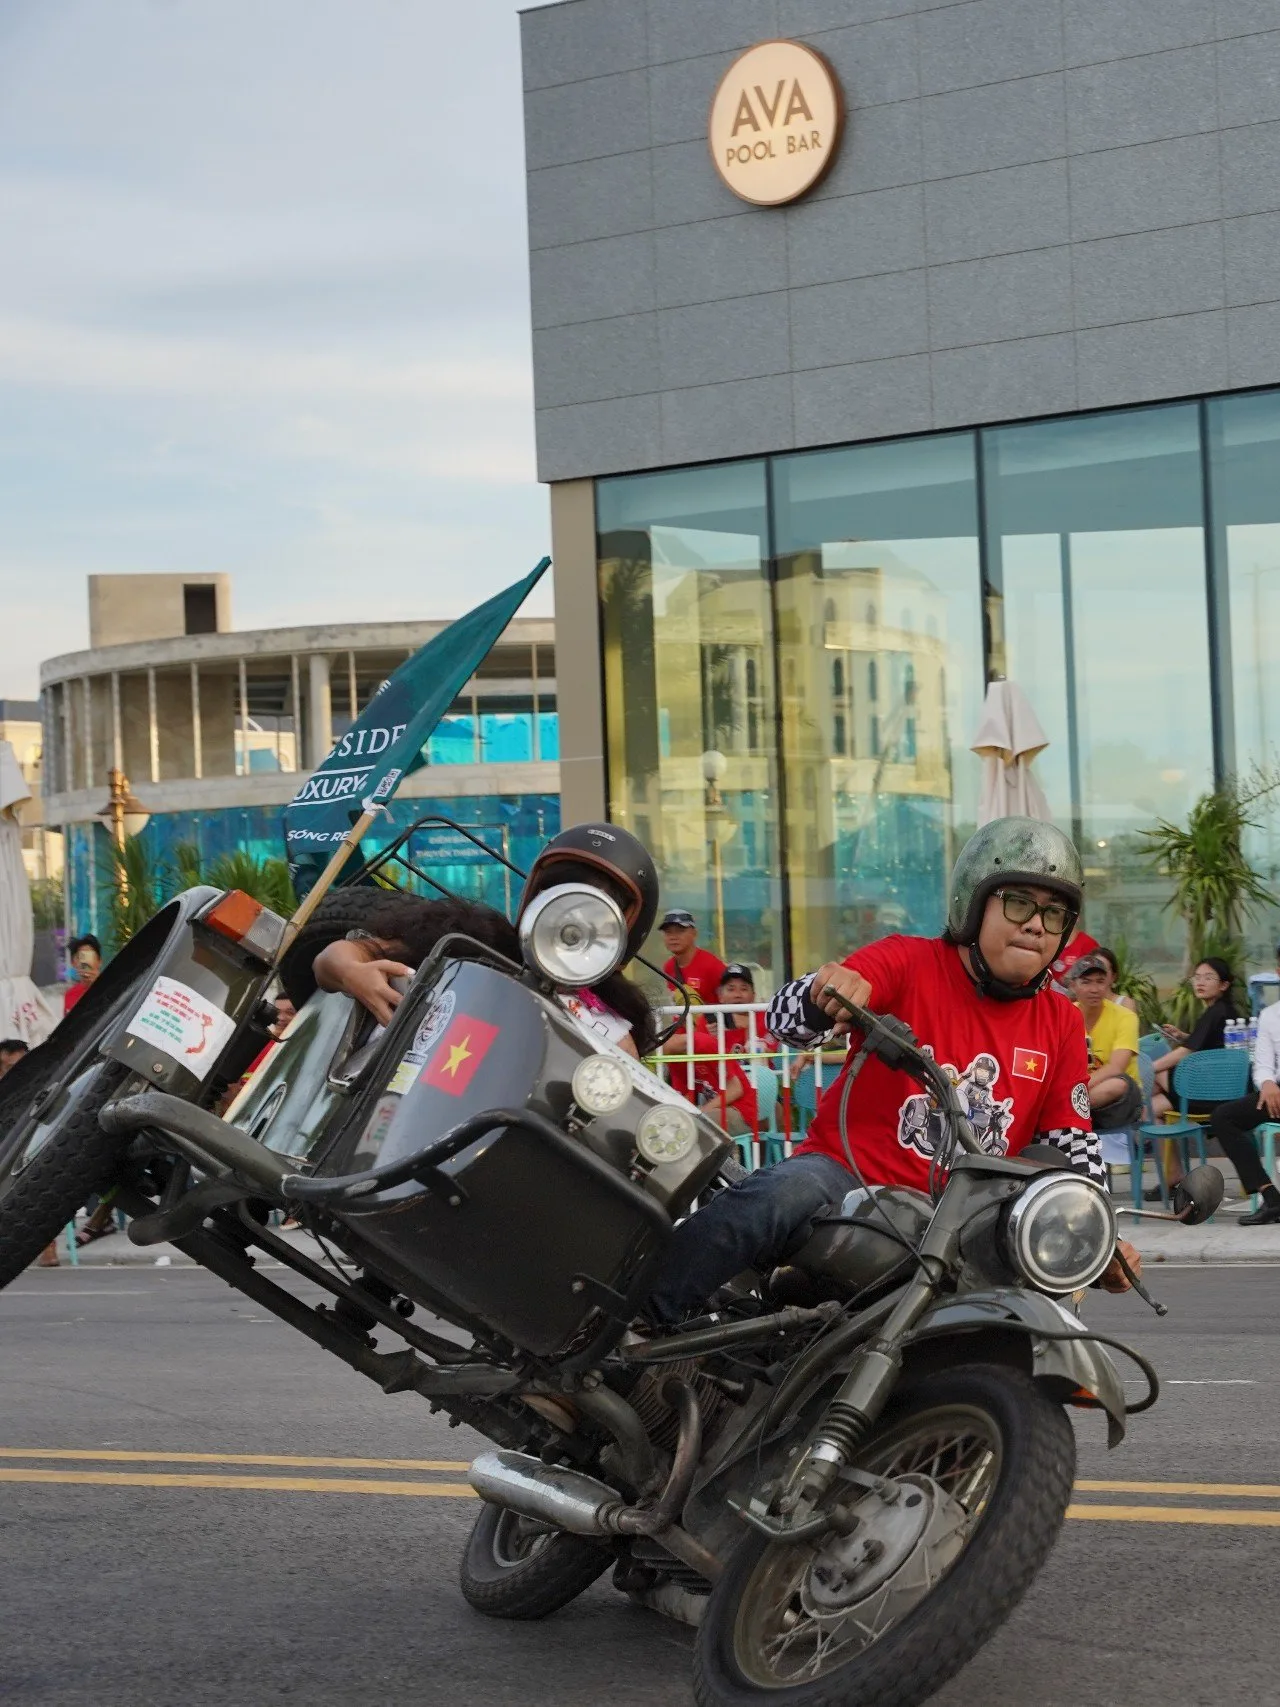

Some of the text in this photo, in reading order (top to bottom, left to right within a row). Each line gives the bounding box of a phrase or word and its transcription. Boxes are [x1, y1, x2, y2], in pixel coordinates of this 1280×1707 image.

[731, 77, 814, 137] AVA
[726, 130, 822, 167] POOL BAR
[328, 724, 407, 759] SIDE
